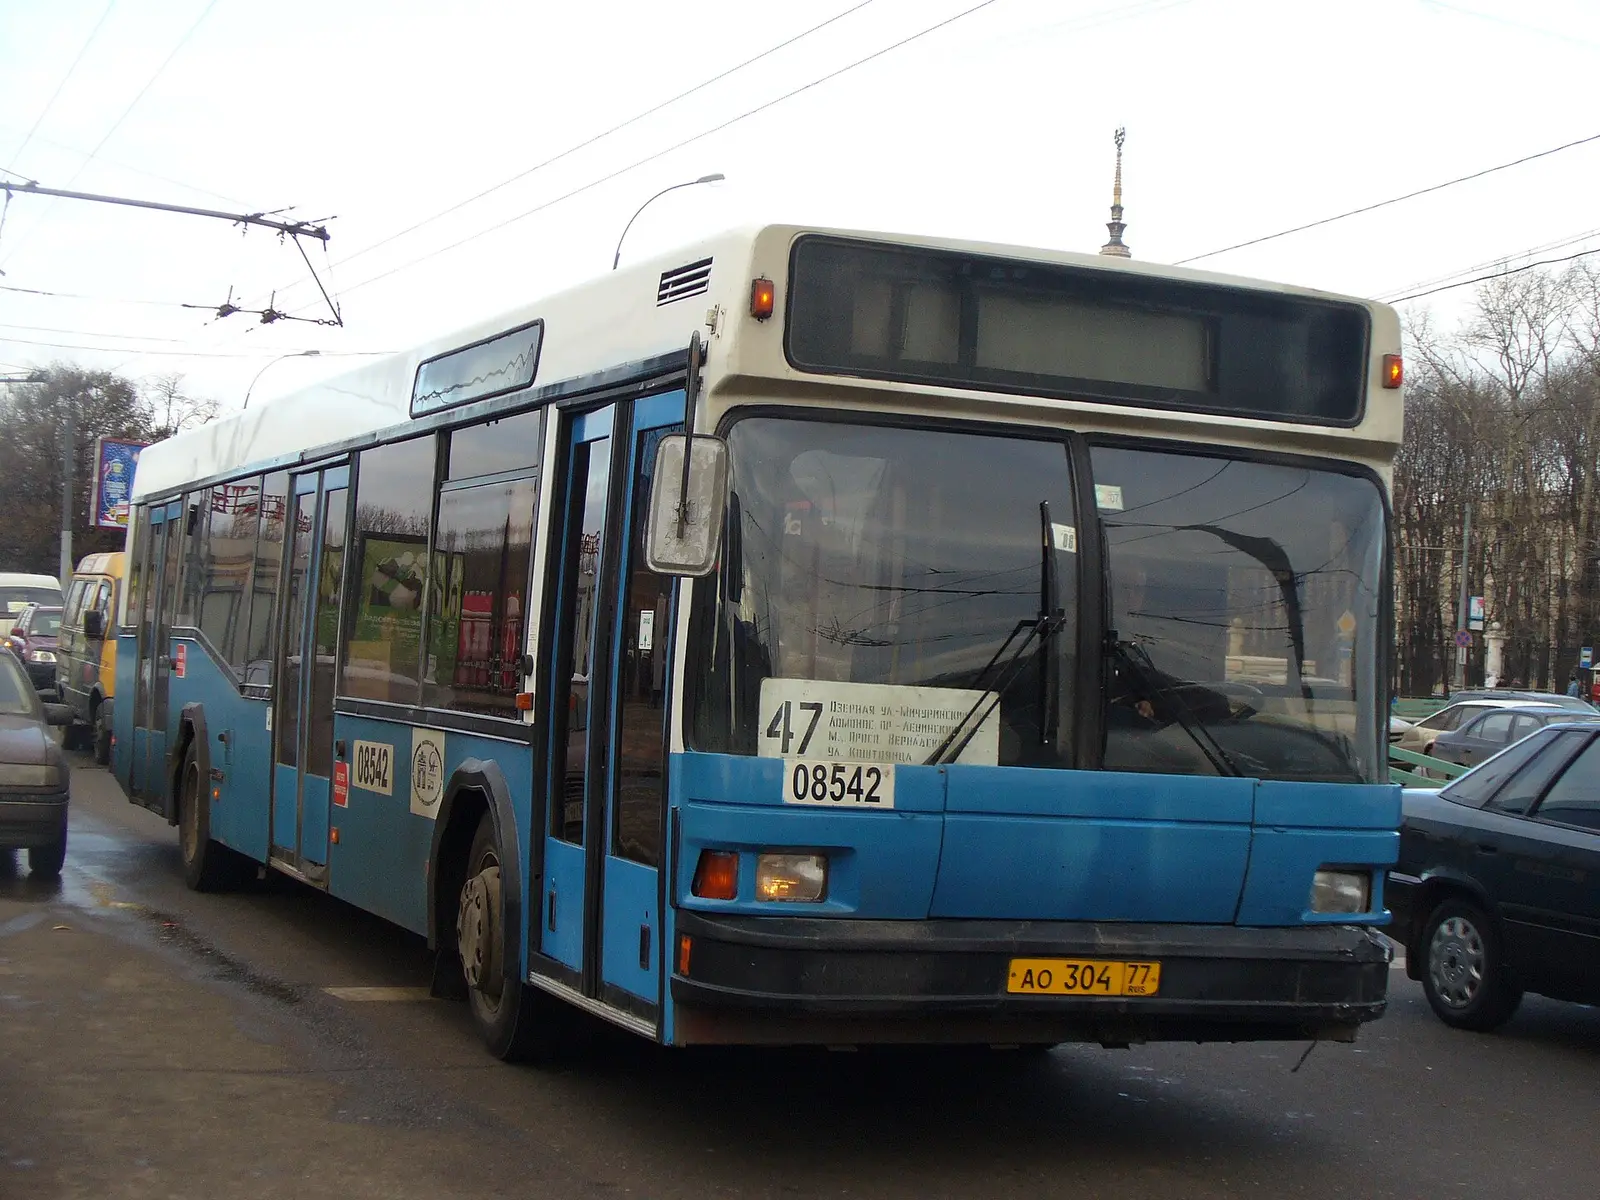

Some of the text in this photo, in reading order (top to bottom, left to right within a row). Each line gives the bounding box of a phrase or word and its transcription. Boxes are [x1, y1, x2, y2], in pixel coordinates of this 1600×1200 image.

[766, 700, 823, 754] 47
[358, 744, 388, 788] 08542
[793, 764, 882, 803] 08542
[1064, 964, 1111, 991] 304
[1128, 964, 1152, 985] 77
[1128, 985, 1147, 993] RUS
